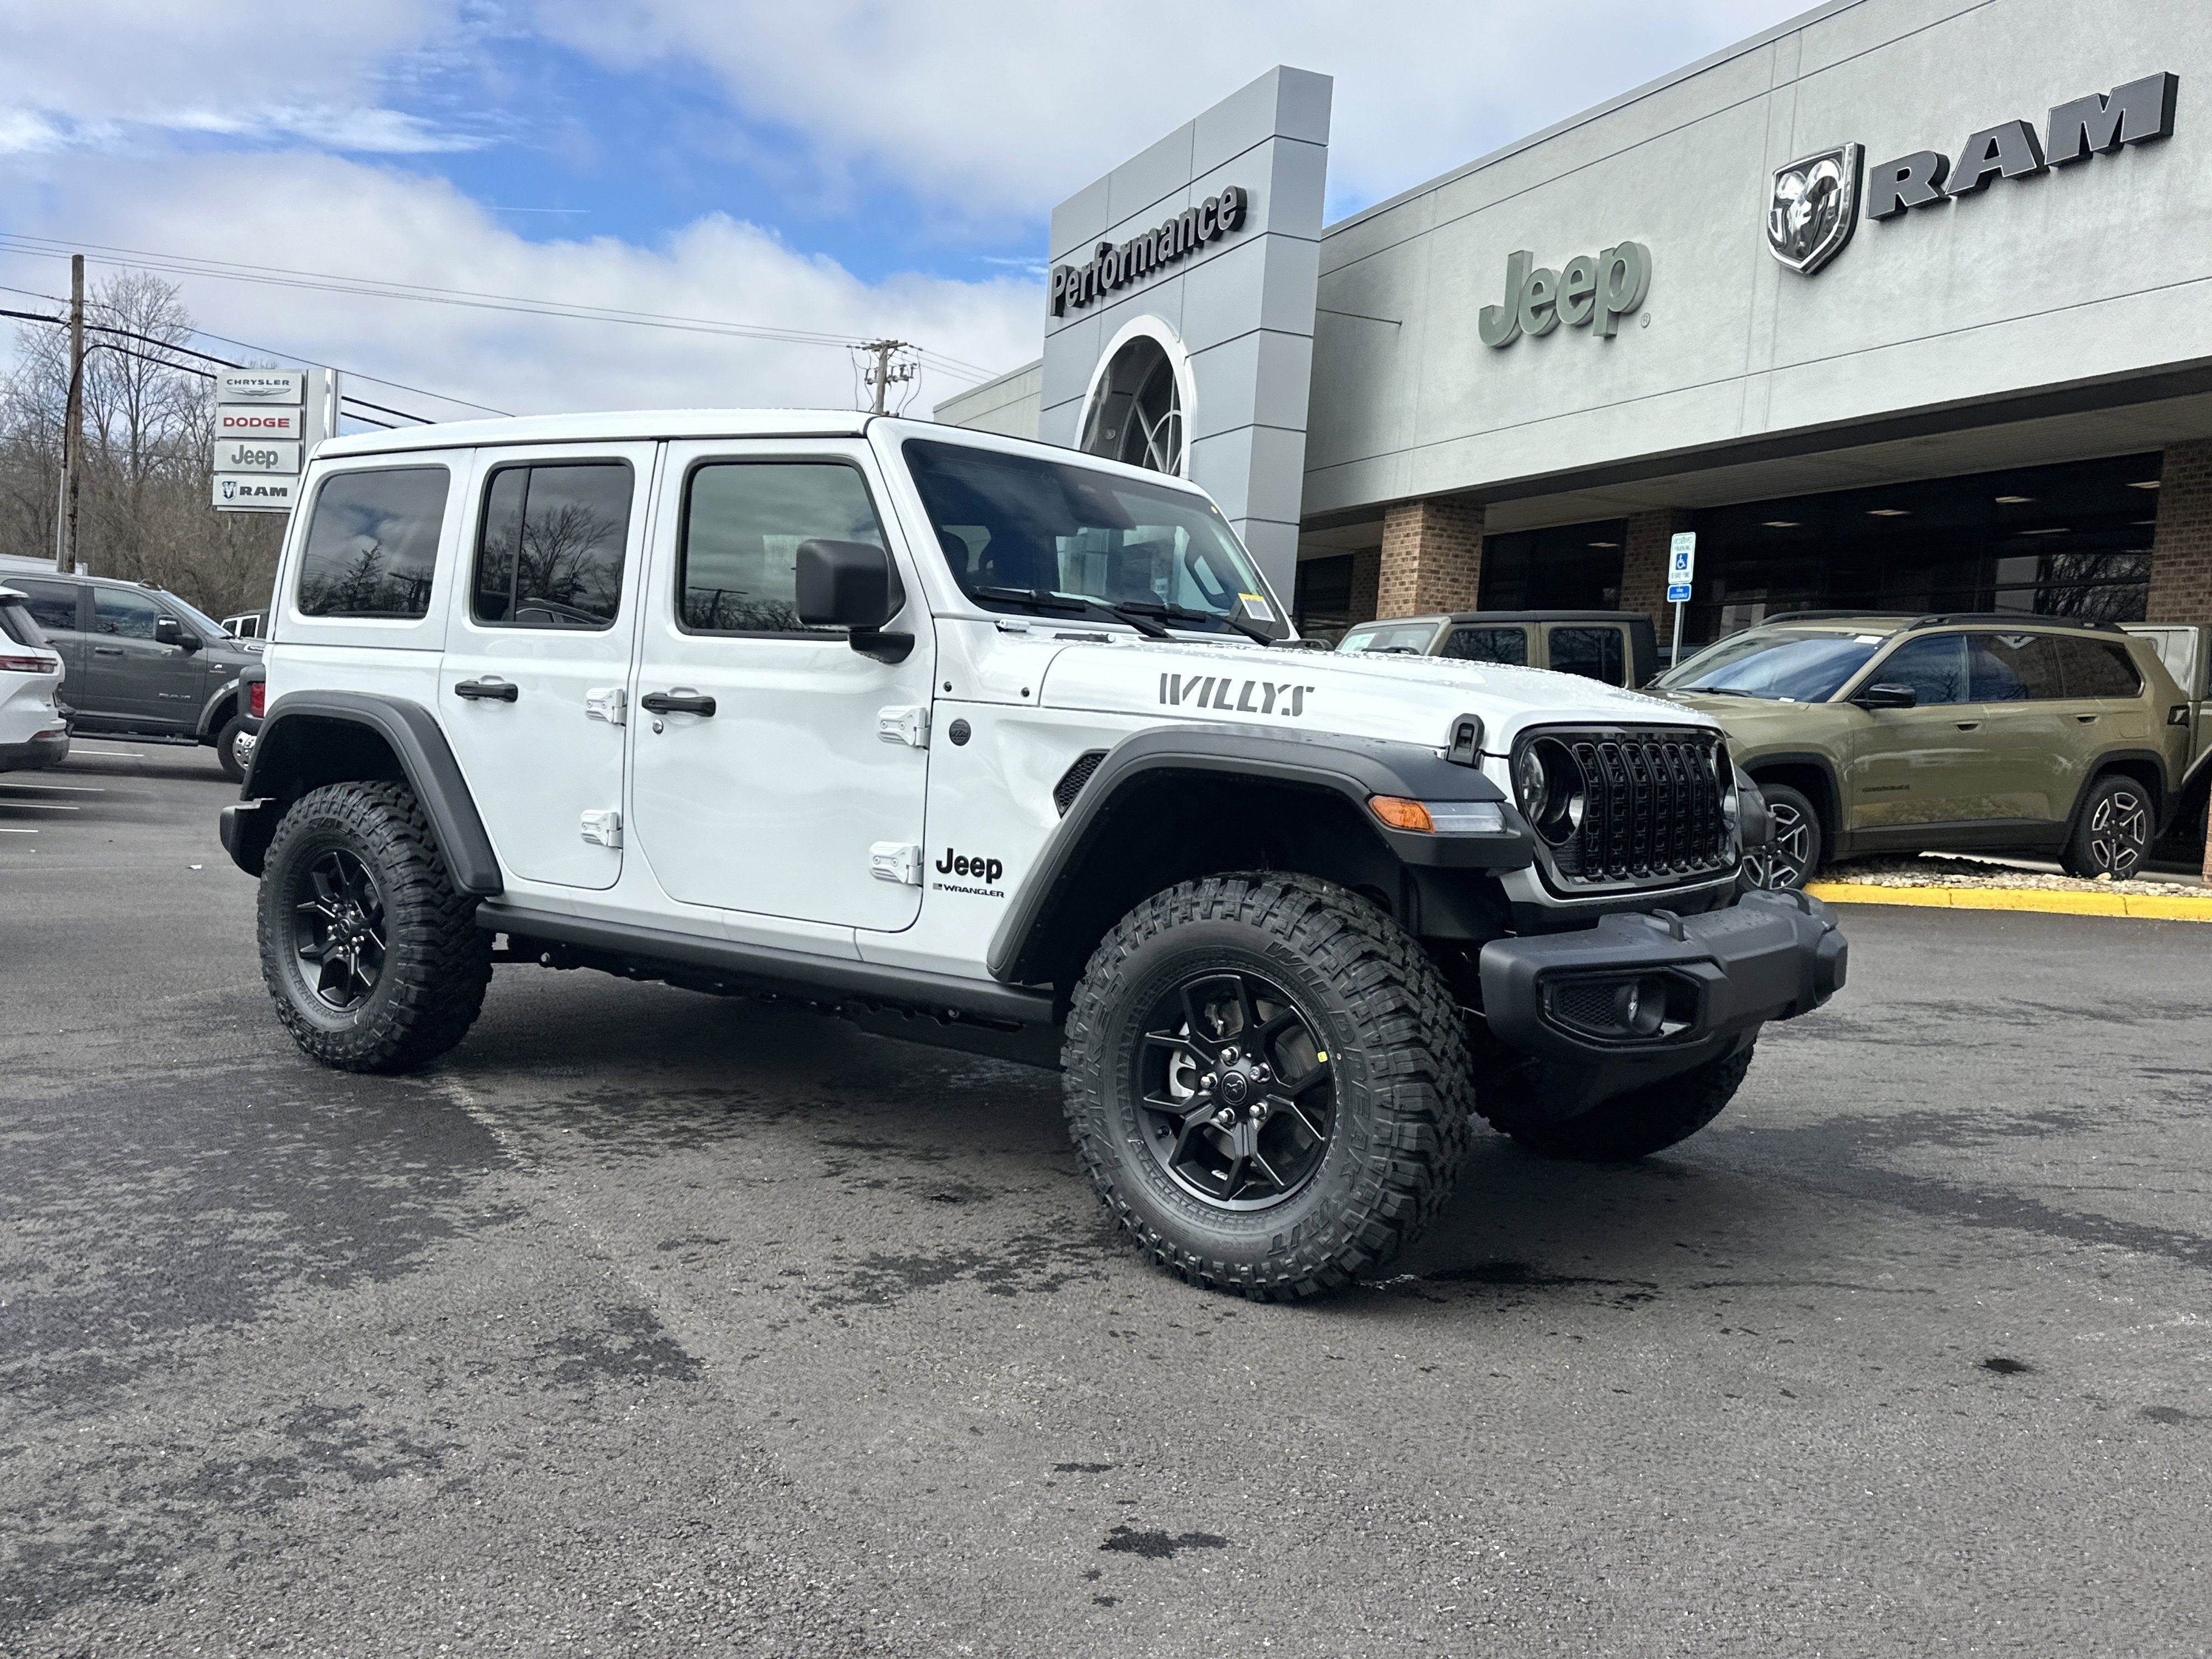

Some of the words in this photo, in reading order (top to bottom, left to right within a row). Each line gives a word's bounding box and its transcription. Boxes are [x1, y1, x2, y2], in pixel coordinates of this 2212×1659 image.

[1866, 72, 2179, 221] RAM
[1050, 185, 1247, 317] Performance
[1478, 241, 1651, 347] Jeep
[223, 417, 290, 428] DODGE
[231, 444, 279, 469] Jeep
[239, 486, 288, 496] RAM
[1159, 673, 1315, 717] WILLYS
[936, 848, 1003, 884] Jeep
[944, 884, 1005, 898] WRANGLER
